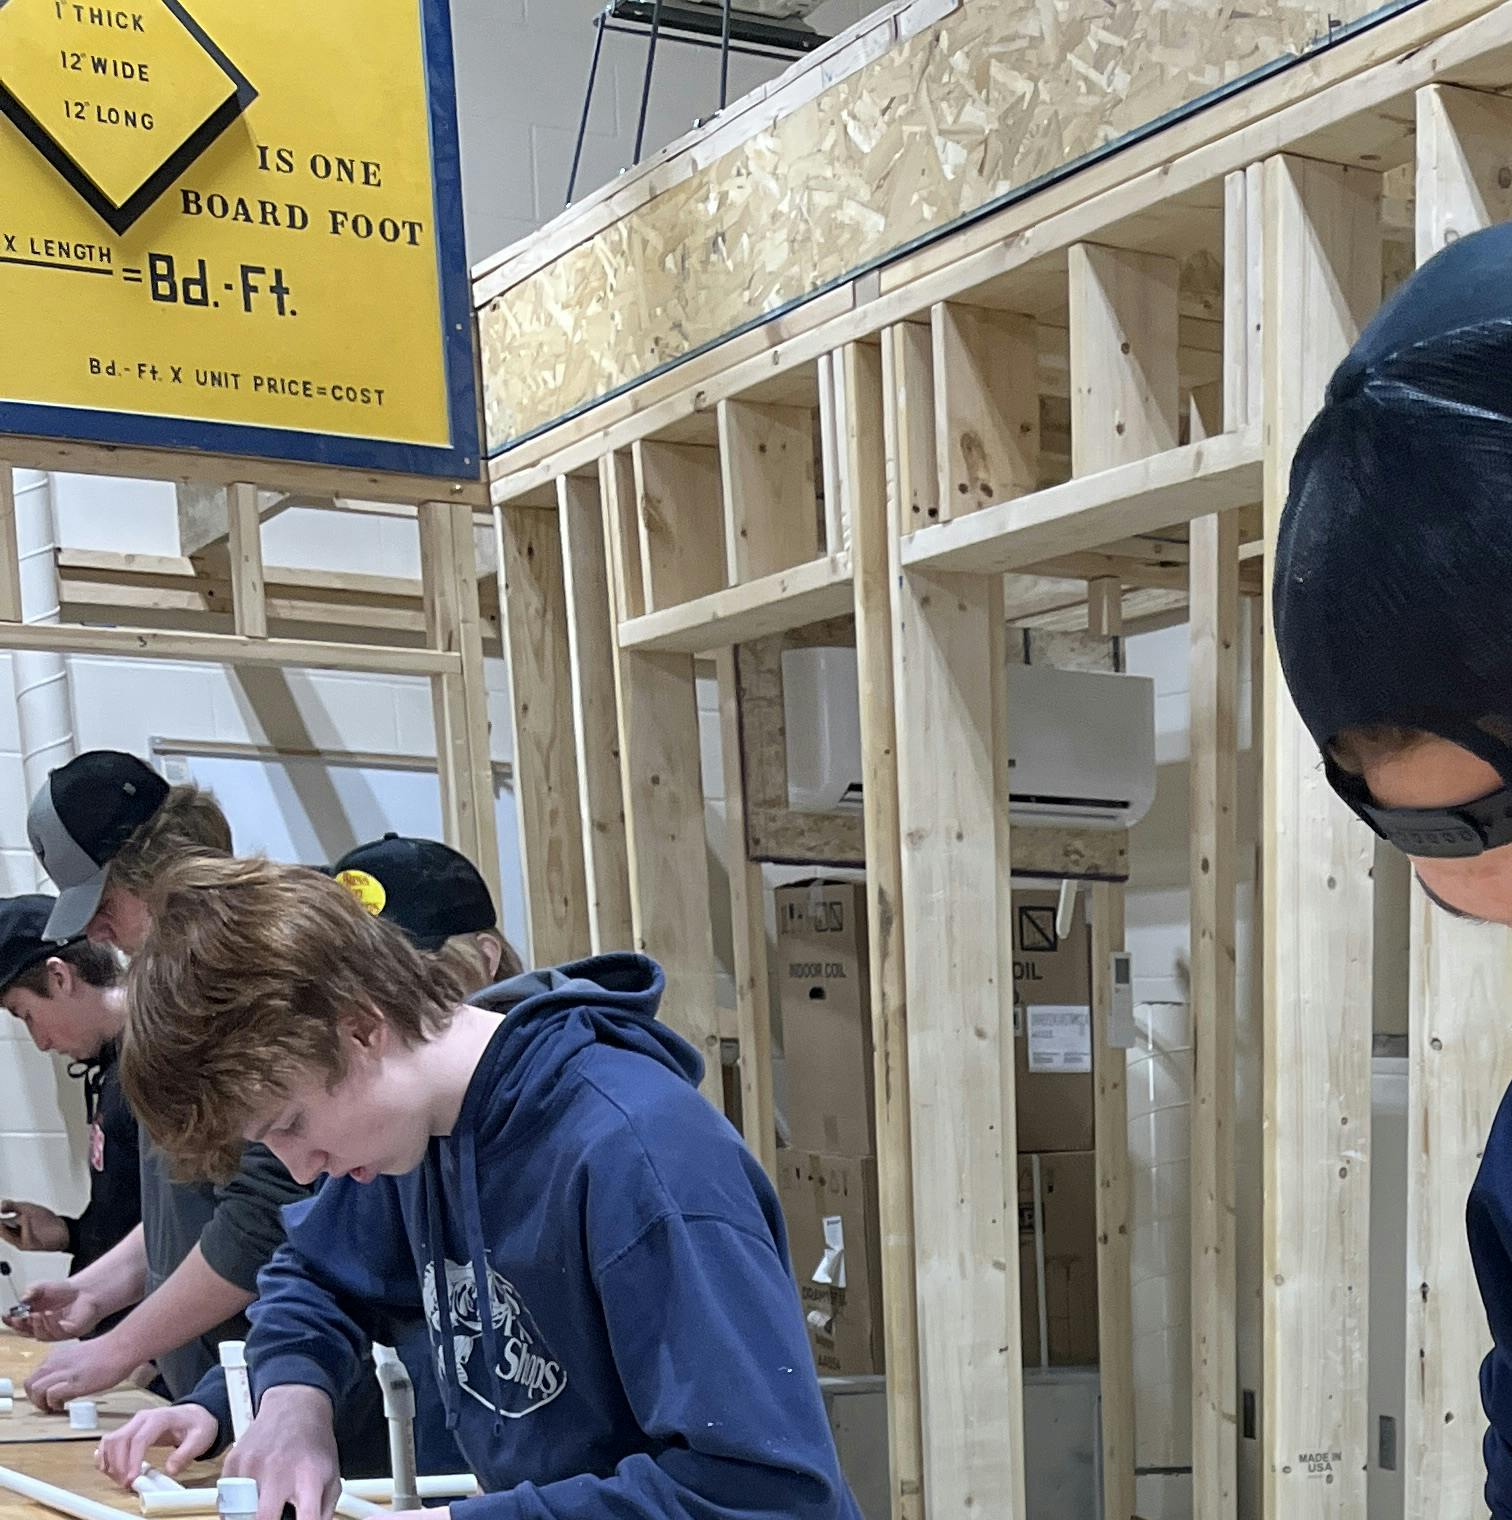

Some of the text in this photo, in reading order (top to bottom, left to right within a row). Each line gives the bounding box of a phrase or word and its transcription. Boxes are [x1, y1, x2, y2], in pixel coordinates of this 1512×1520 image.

[74, 4, 145, 33] THICK
[91, 56, 150, 82] WIDE
[96, 106, 155, 131] LONG
[257, 145, 382, 187] IS ONE
[181, 189, 424, 246] BOARD FOOT
[3, 234, 113, 264] X LENGTH
[170, 366, 183, 384] X
[196, 369, 240, 390] UNIT
[1013, 961, 1043, 981] OIL
[1298, 1451, 1342, 1464] MADE IN
[1307, 1463, 1333, 1473] USA
